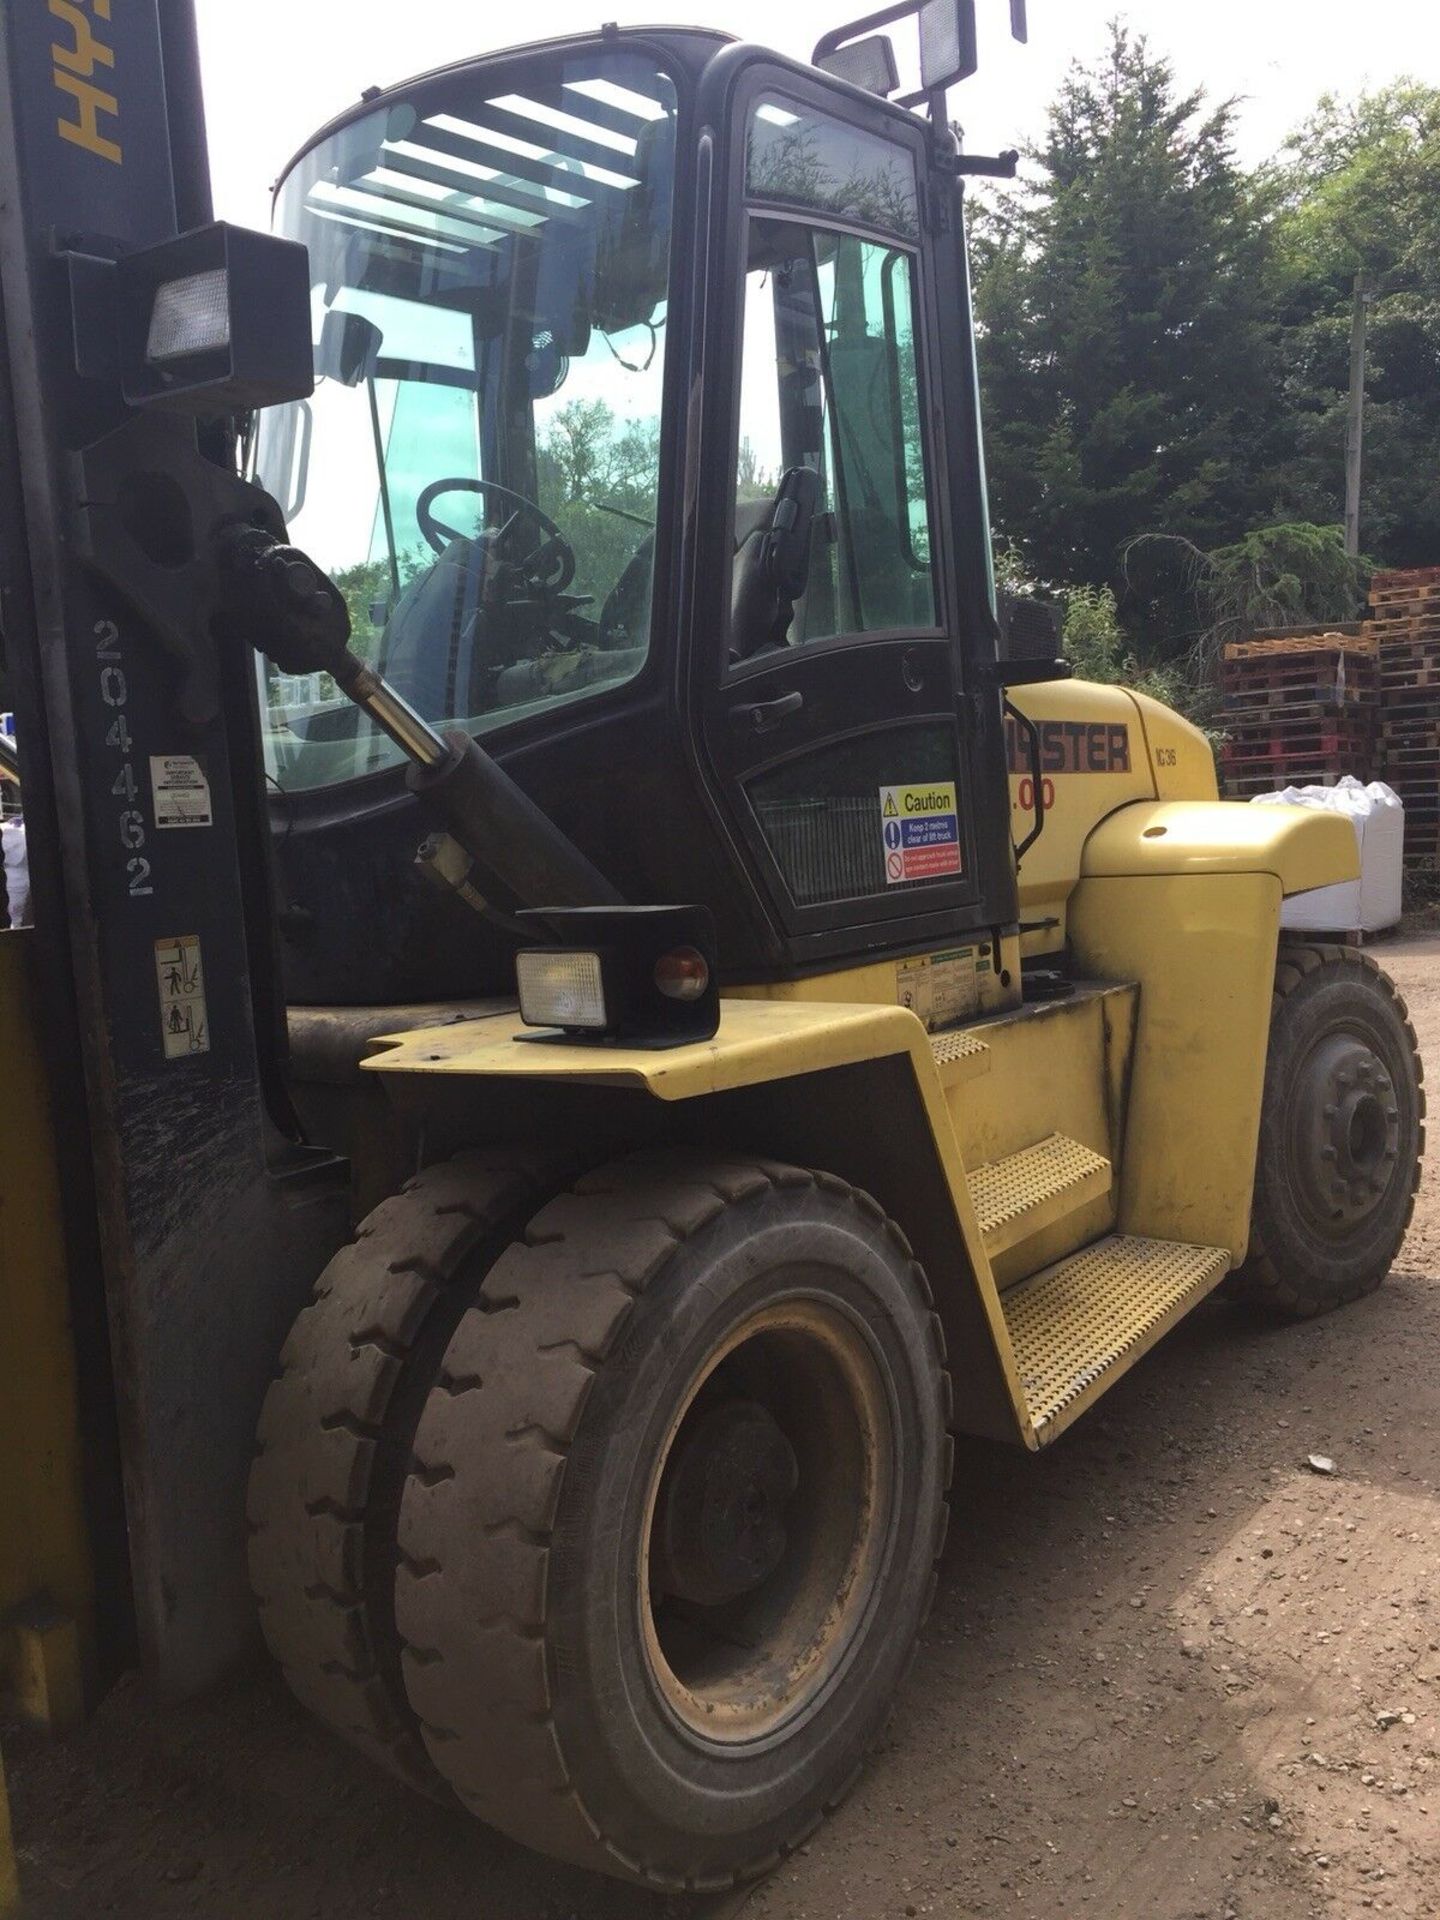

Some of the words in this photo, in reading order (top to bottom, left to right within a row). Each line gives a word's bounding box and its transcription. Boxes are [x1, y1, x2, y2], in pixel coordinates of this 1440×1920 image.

[93, 619, 154, 897] 204462
[904, 792, 951, 812] Caution
[909, 823, 924, 833] Keep
[907, 834, 921, 844] clear
[937, 831, 952, 841] truck
